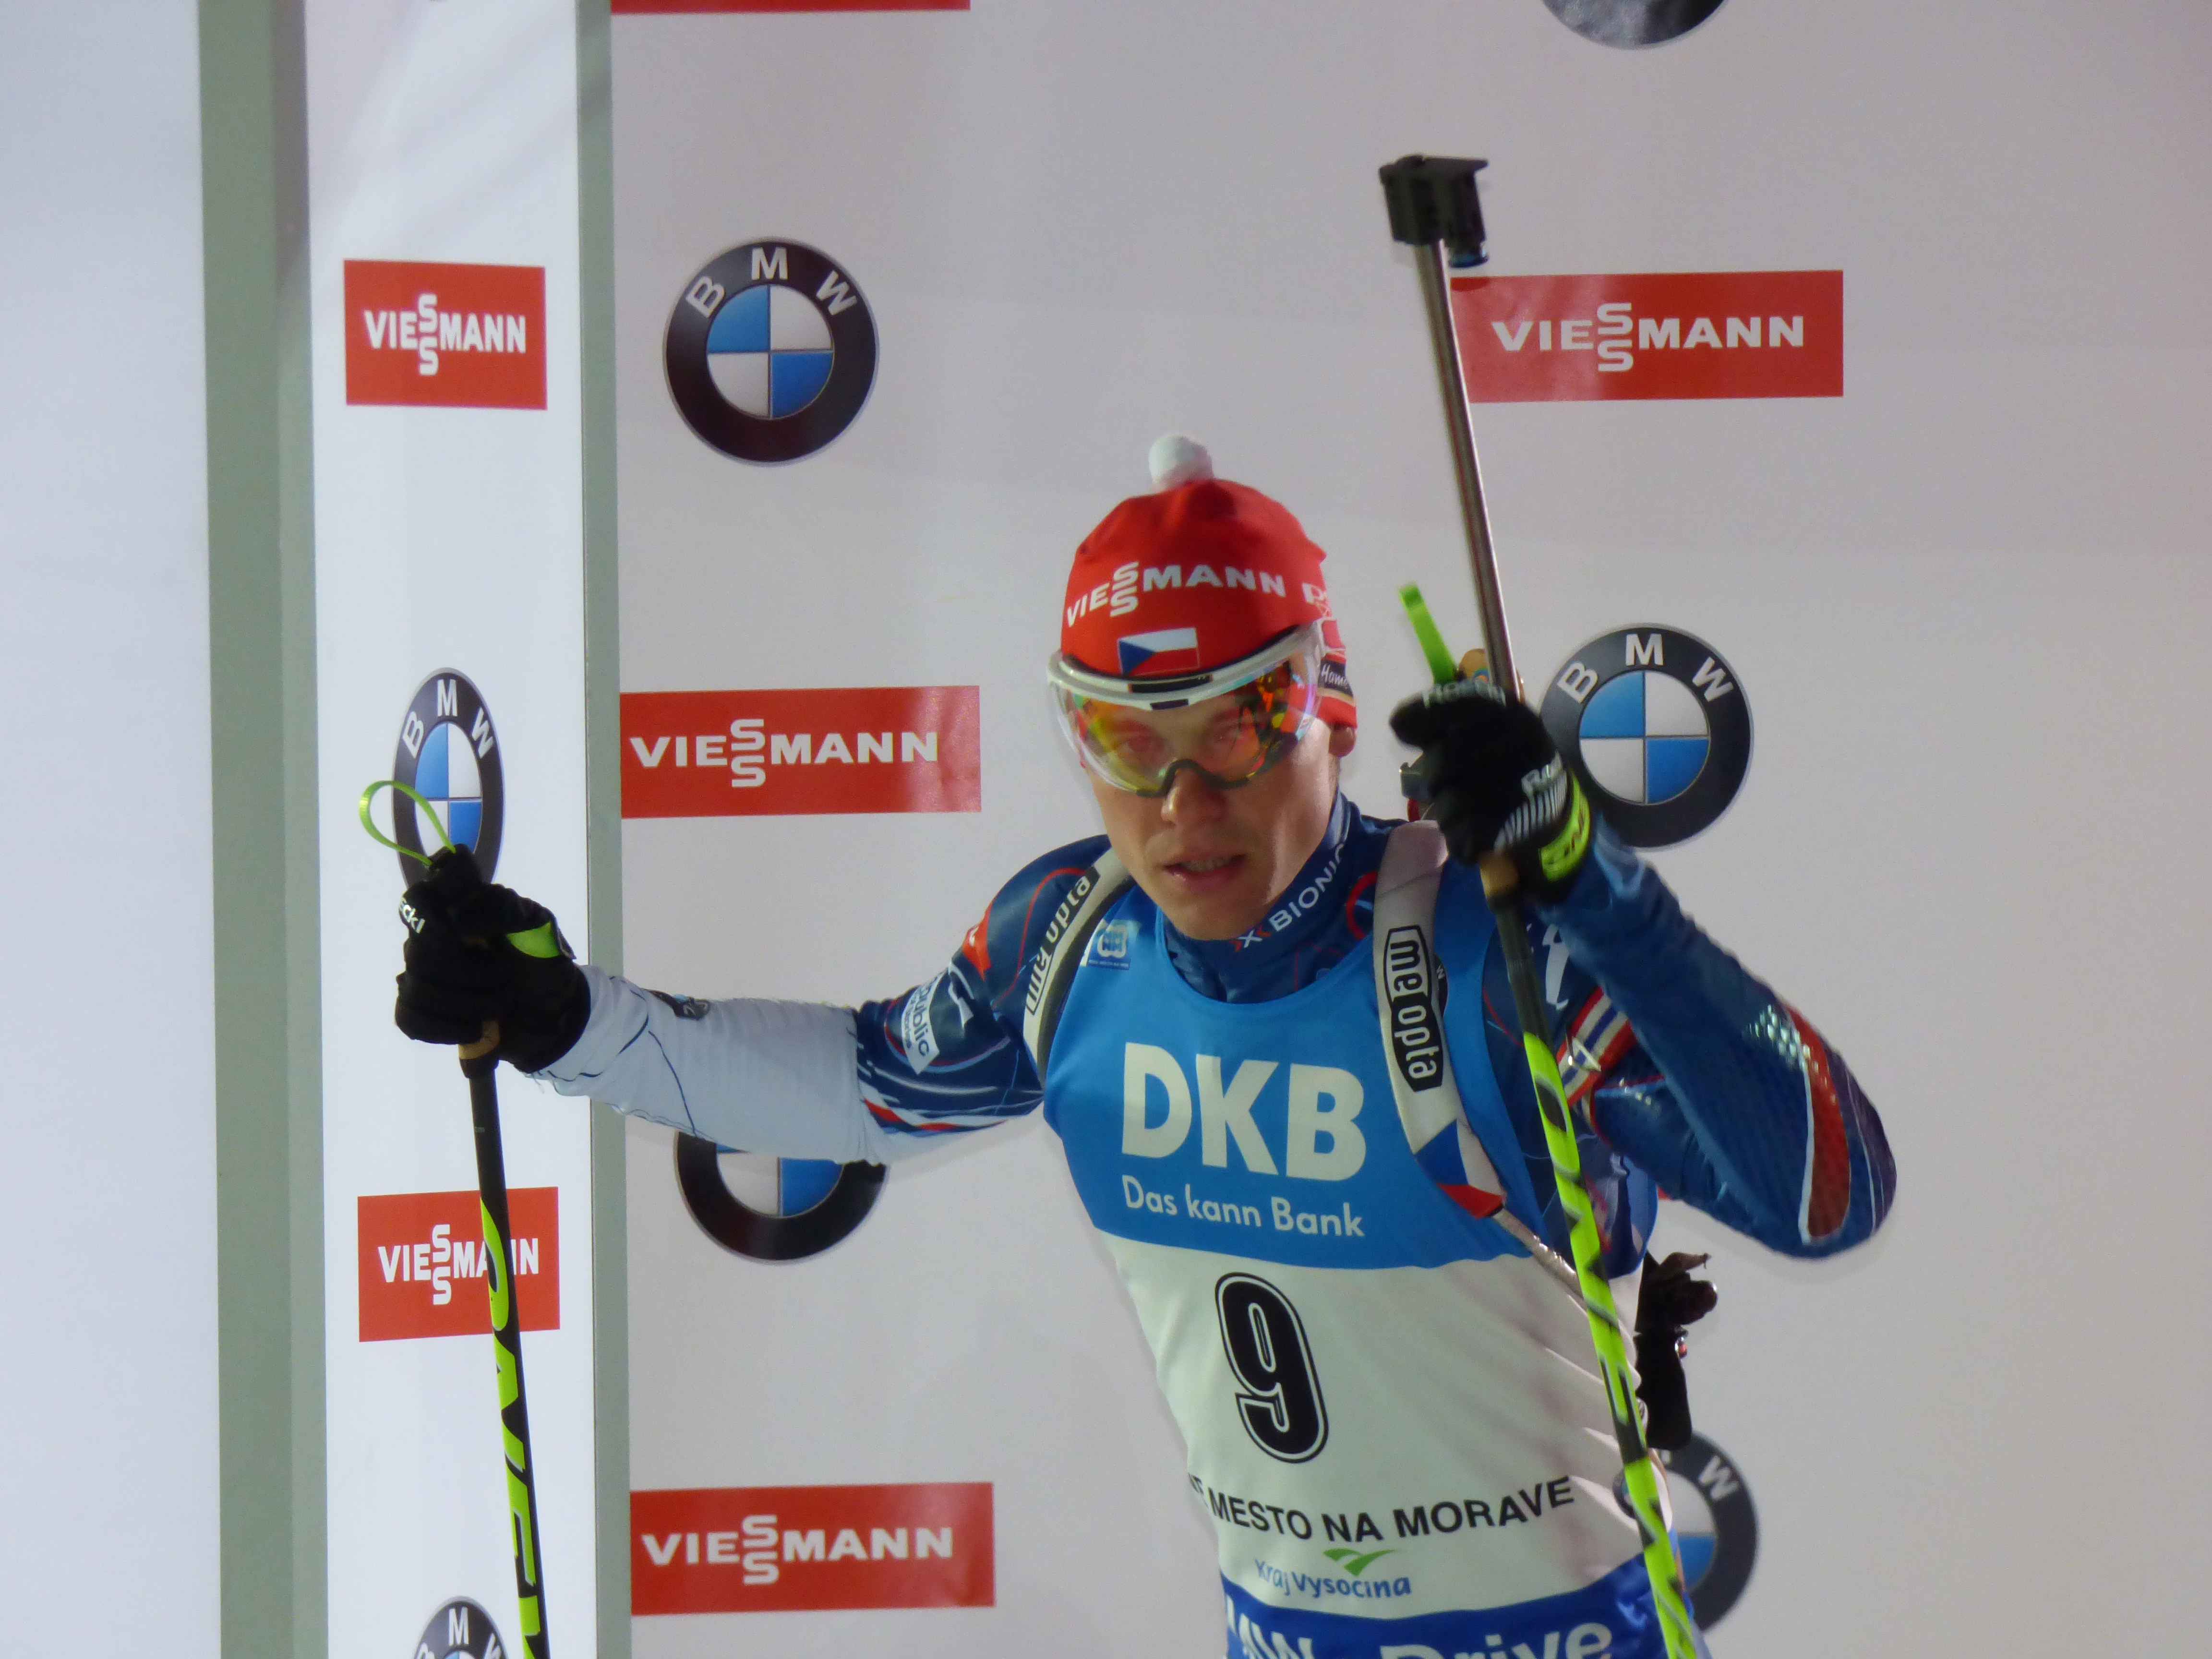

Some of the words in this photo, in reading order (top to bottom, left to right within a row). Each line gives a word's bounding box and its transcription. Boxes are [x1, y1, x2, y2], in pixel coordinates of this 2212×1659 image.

[685, 247, 857, 318] BMW
[364, 293, 526, 376] VIESSMANN
[1491, 302, 1804, 372] VIESSMANN
[1066, 562, 1286, 627] VIESSMANN
[1557, 634, 1734, 704] BMW
[402, 679, 494, 759] BMW
[630, 719, 938, 787] VIESSMANN
[1122, 1042, 1366, 1181] DKB
[1122, 1175, 1178, 1215] Das
[1185, 1184, 1262, 1227] kann
[1271, 1196, 1365, 1237] Bank
[378, 1224, 539, 1305] VIESSMAN
[1214, 1272, 1329, 1464] 9
[1208, 1487, 1312, 1539] MESTO
[1322, 1512, 1384, 1542] NA
[1393, 1475, 1574, 1538] MORAVE
[641, 1515, 953, 1585] VIESSMANN
